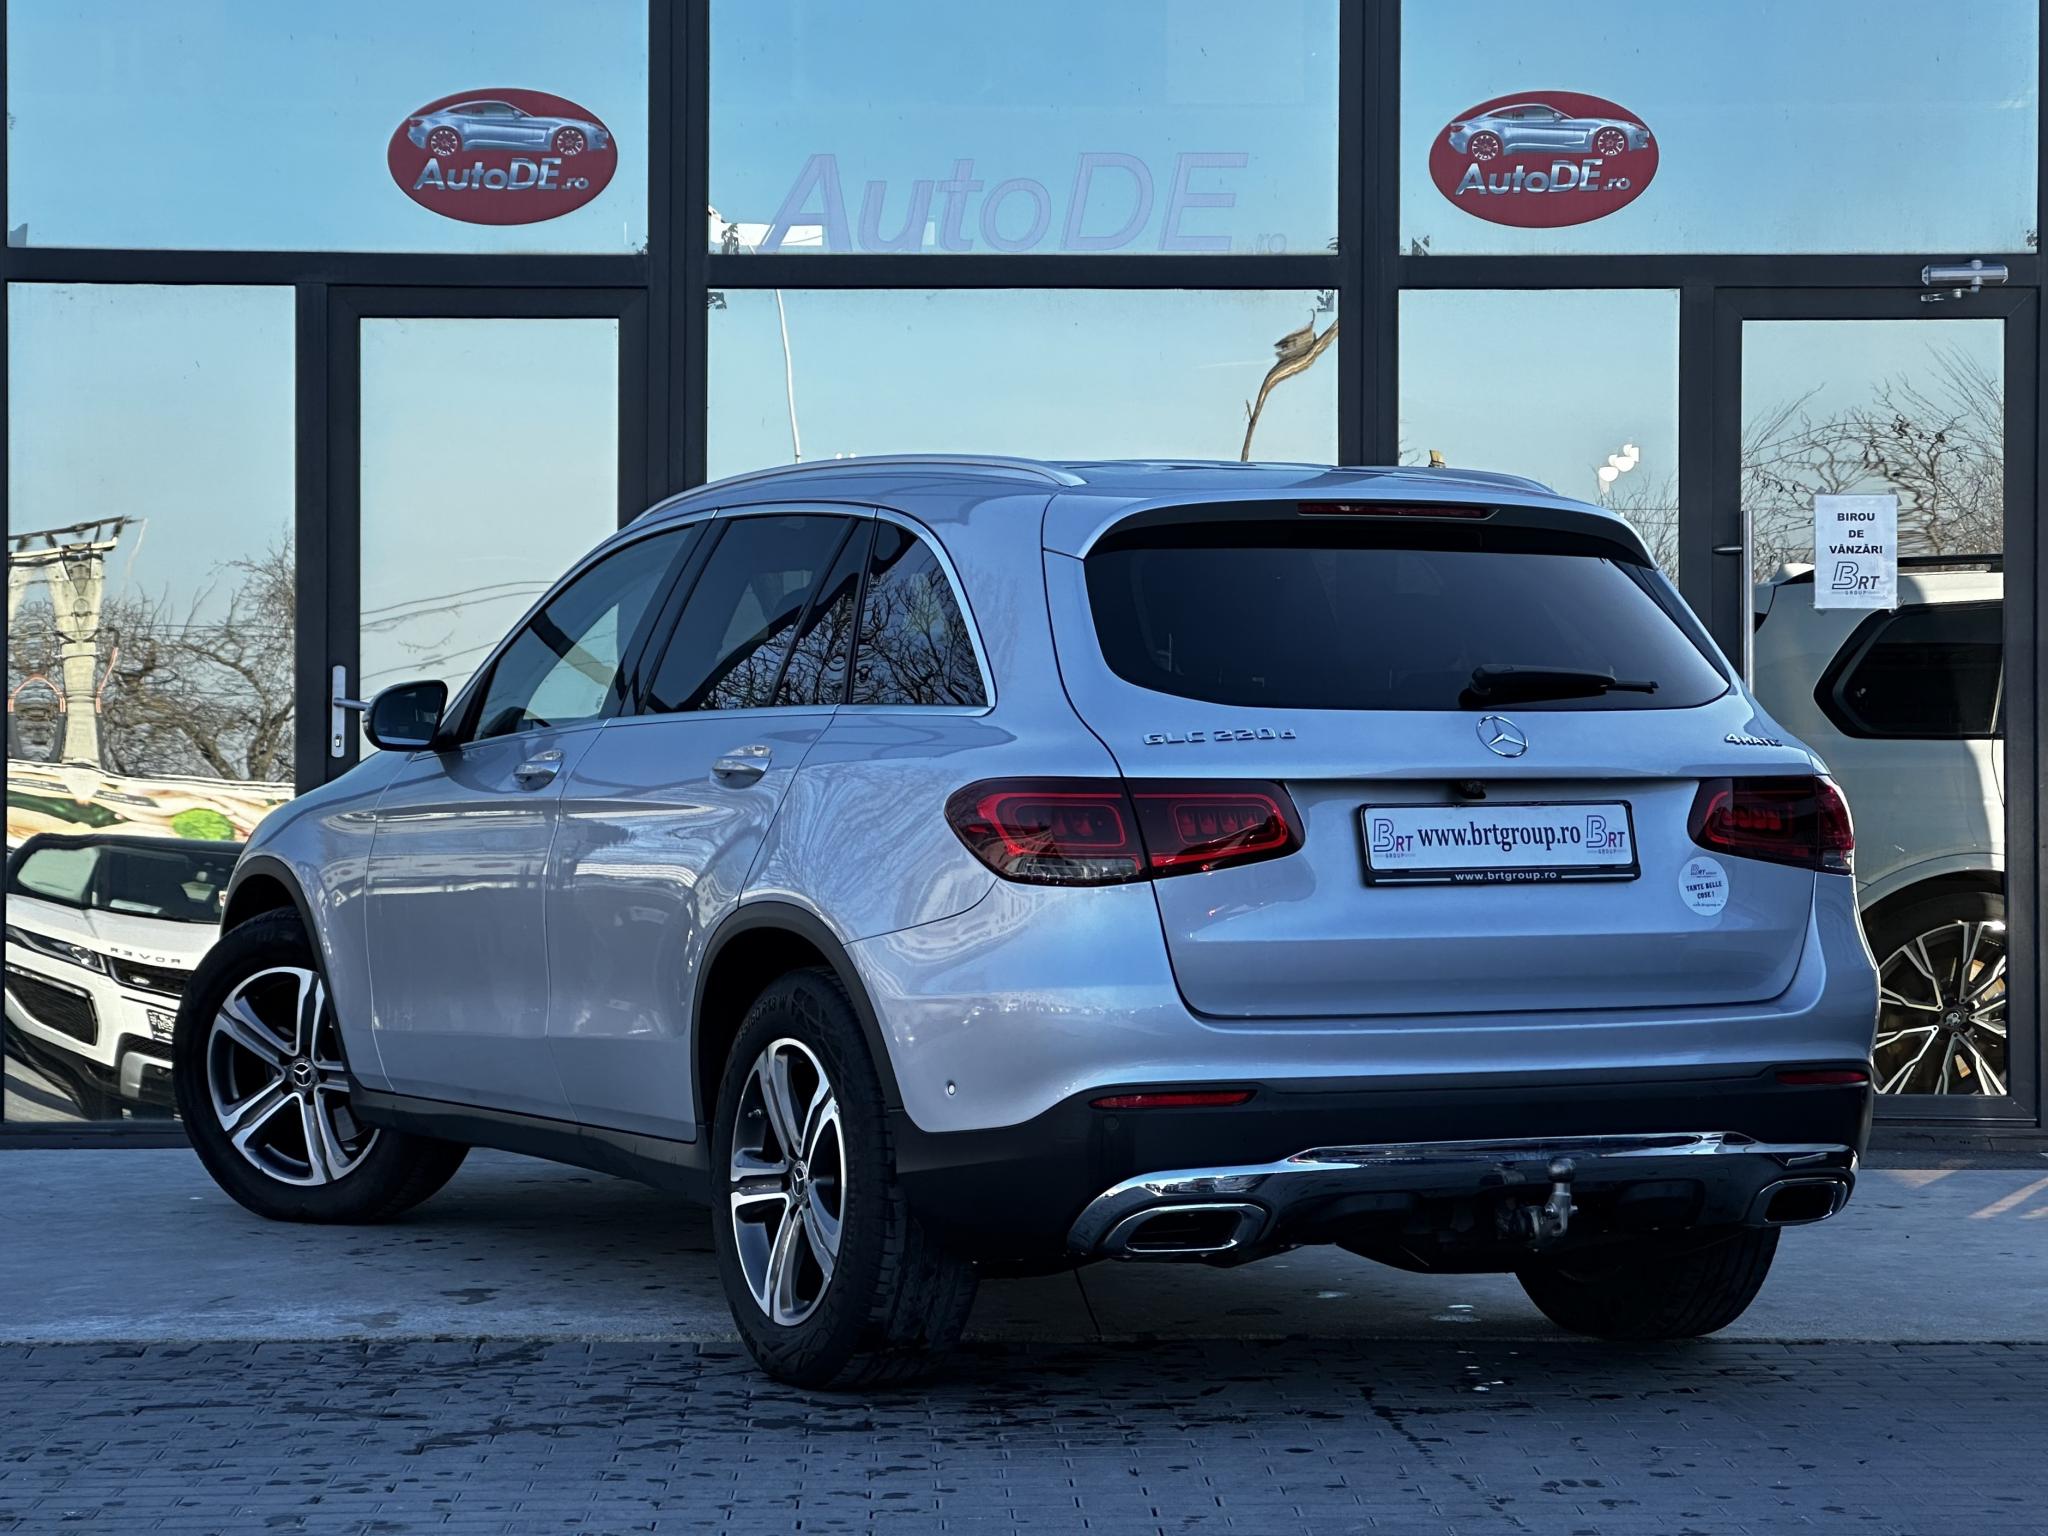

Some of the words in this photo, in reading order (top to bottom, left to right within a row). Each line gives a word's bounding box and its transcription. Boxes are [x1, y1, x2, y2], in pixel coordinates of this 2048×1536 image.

[413, 157, 589, 191] AutoDE.ro
[1455, 158, 1631, 196] AutoDE.ro
[1837, 512, 1876, 522] BIROU
[1848, 529, 1864, 538] DE
[1831, 561, 1880, 590] BRT
[1143, 731, 1207, 745] GLC
[1373, 818, 1414, 853] BRT
[1417, 821, 1581, 852] www.brtgroup.ro
[1586, 815, 1626, 848] BRT
[1455, 871, 1557, 882] www.brtgroup.ro
[1686, 883, 1704, 892] TANTE
[1705, 881, 1722, 890] BELLE
